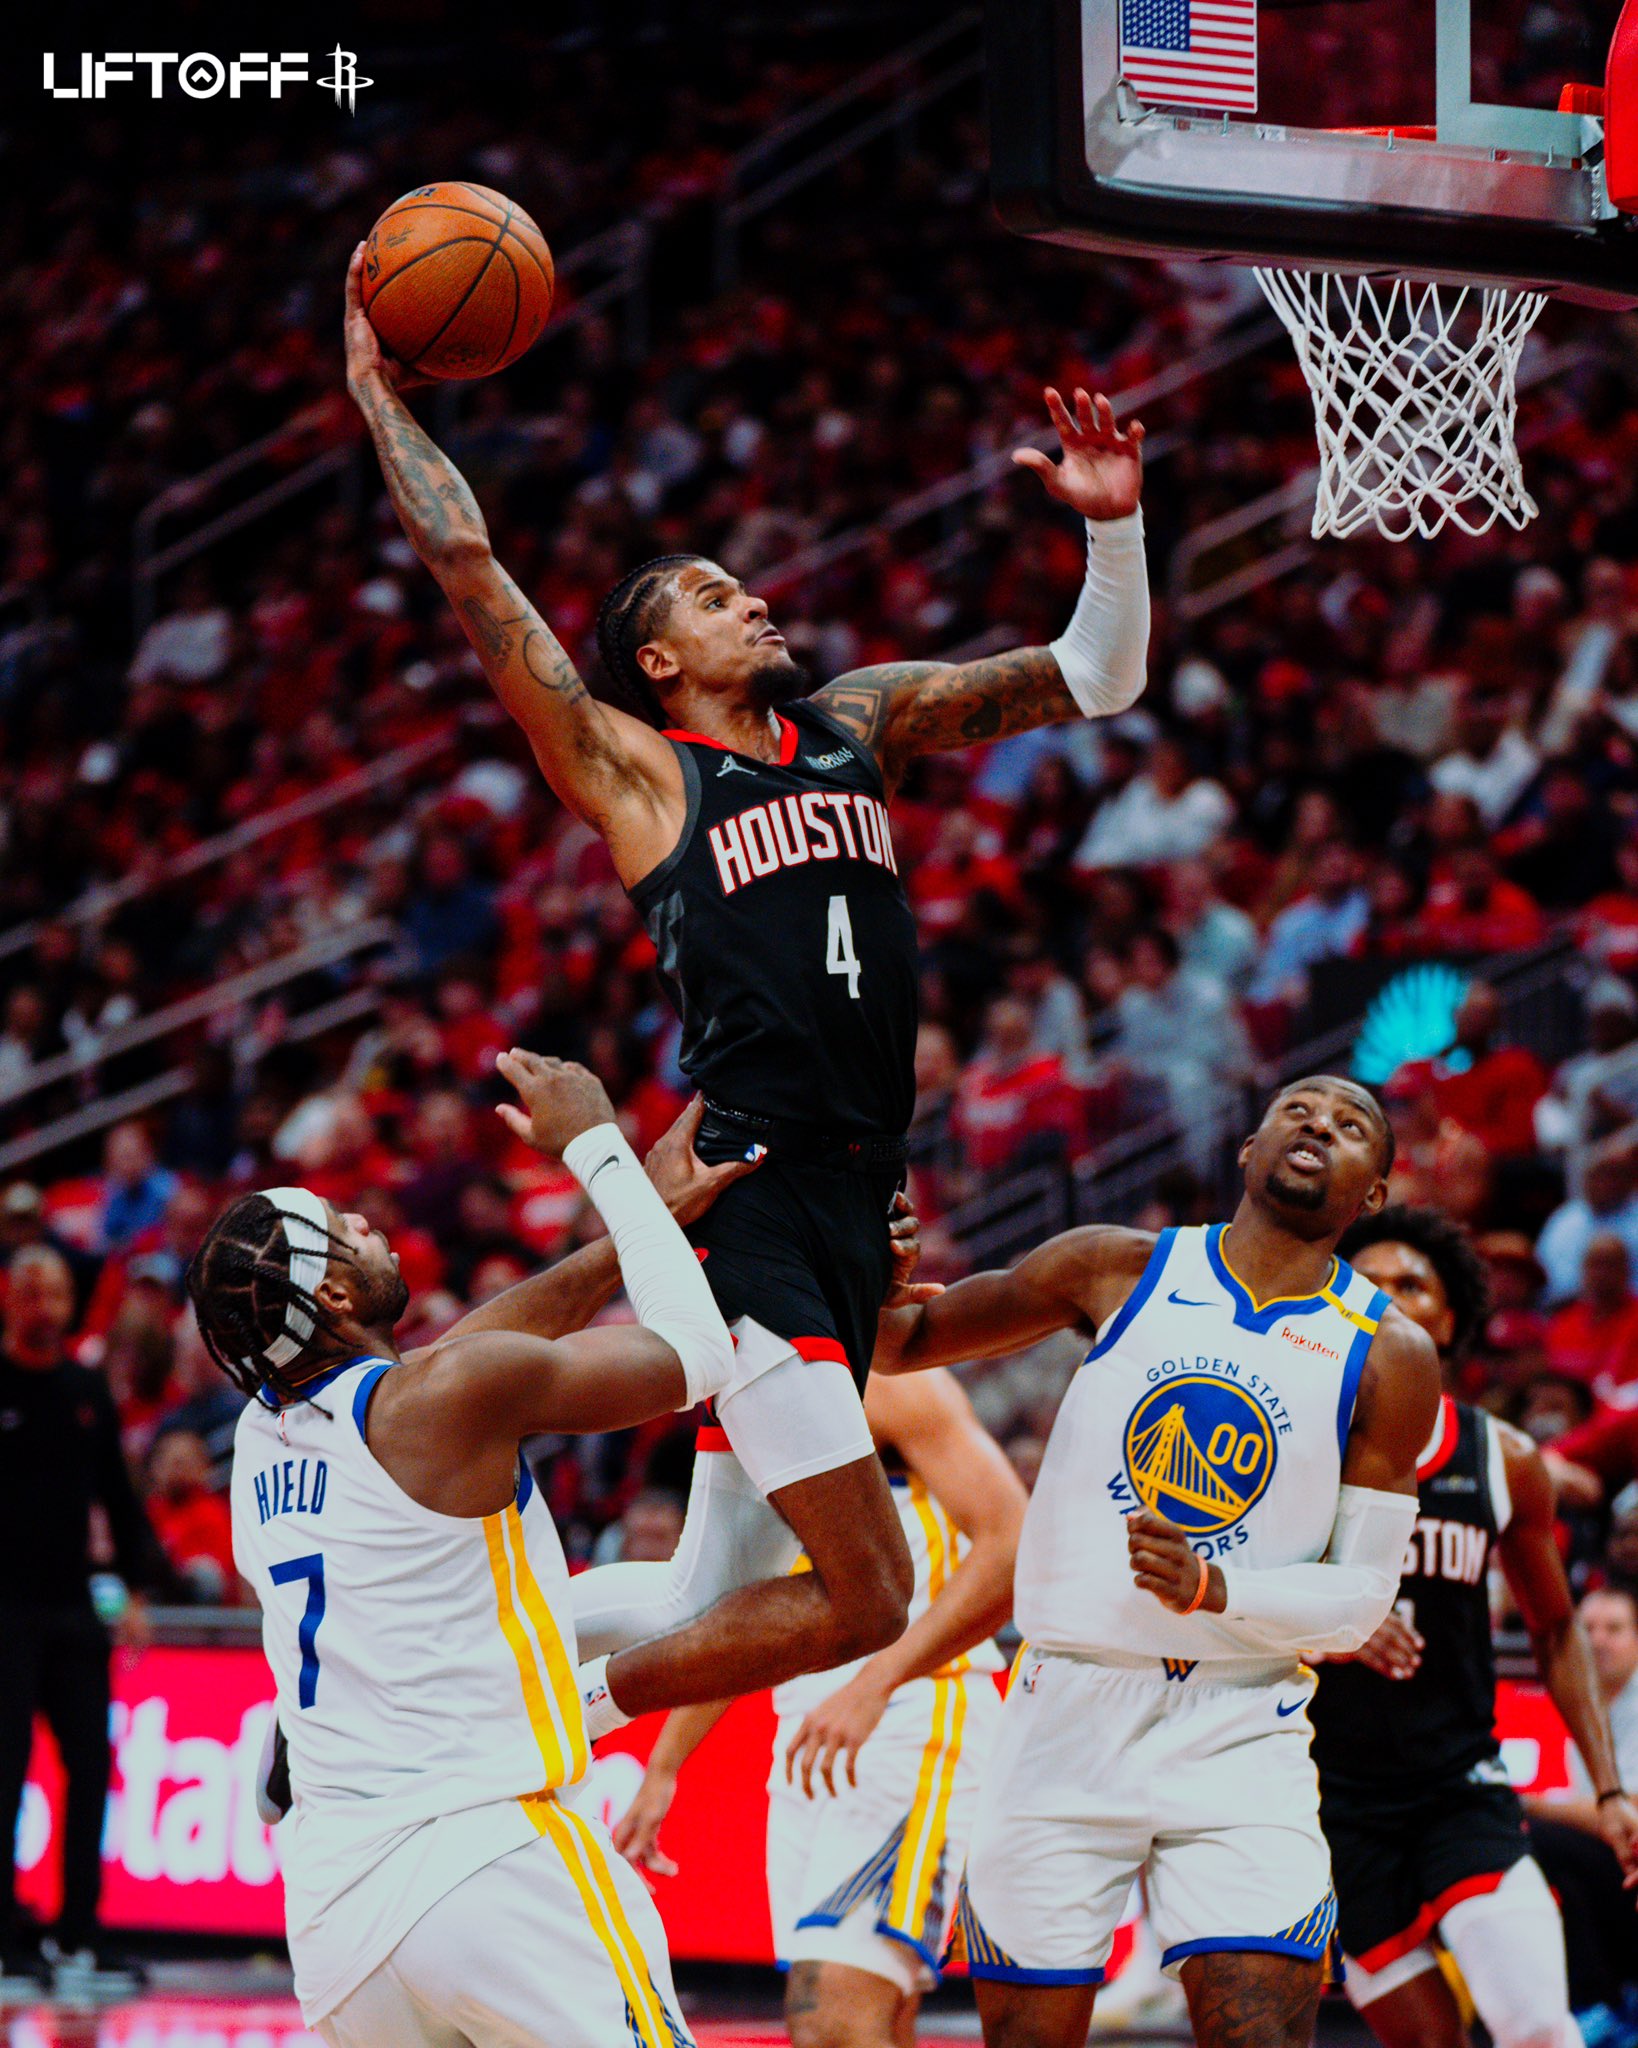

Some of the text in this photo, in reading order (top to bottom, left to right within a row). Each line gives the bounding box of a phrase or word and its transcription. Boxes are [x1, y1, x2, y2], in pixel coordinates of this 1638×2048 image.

[708, 791, 898, 897] HOUSTON
[826, 895, 861, 999] 4
[1281, 1326, 1340, 1361] Rakuten
[1146, 1356, 1293, 1436] GOLDEN STATE
[1206, 1422, 1264, 1476] 00
[254, 1458, 328, 1525] HIELD
[268, 1552, 326, 1710] 7
